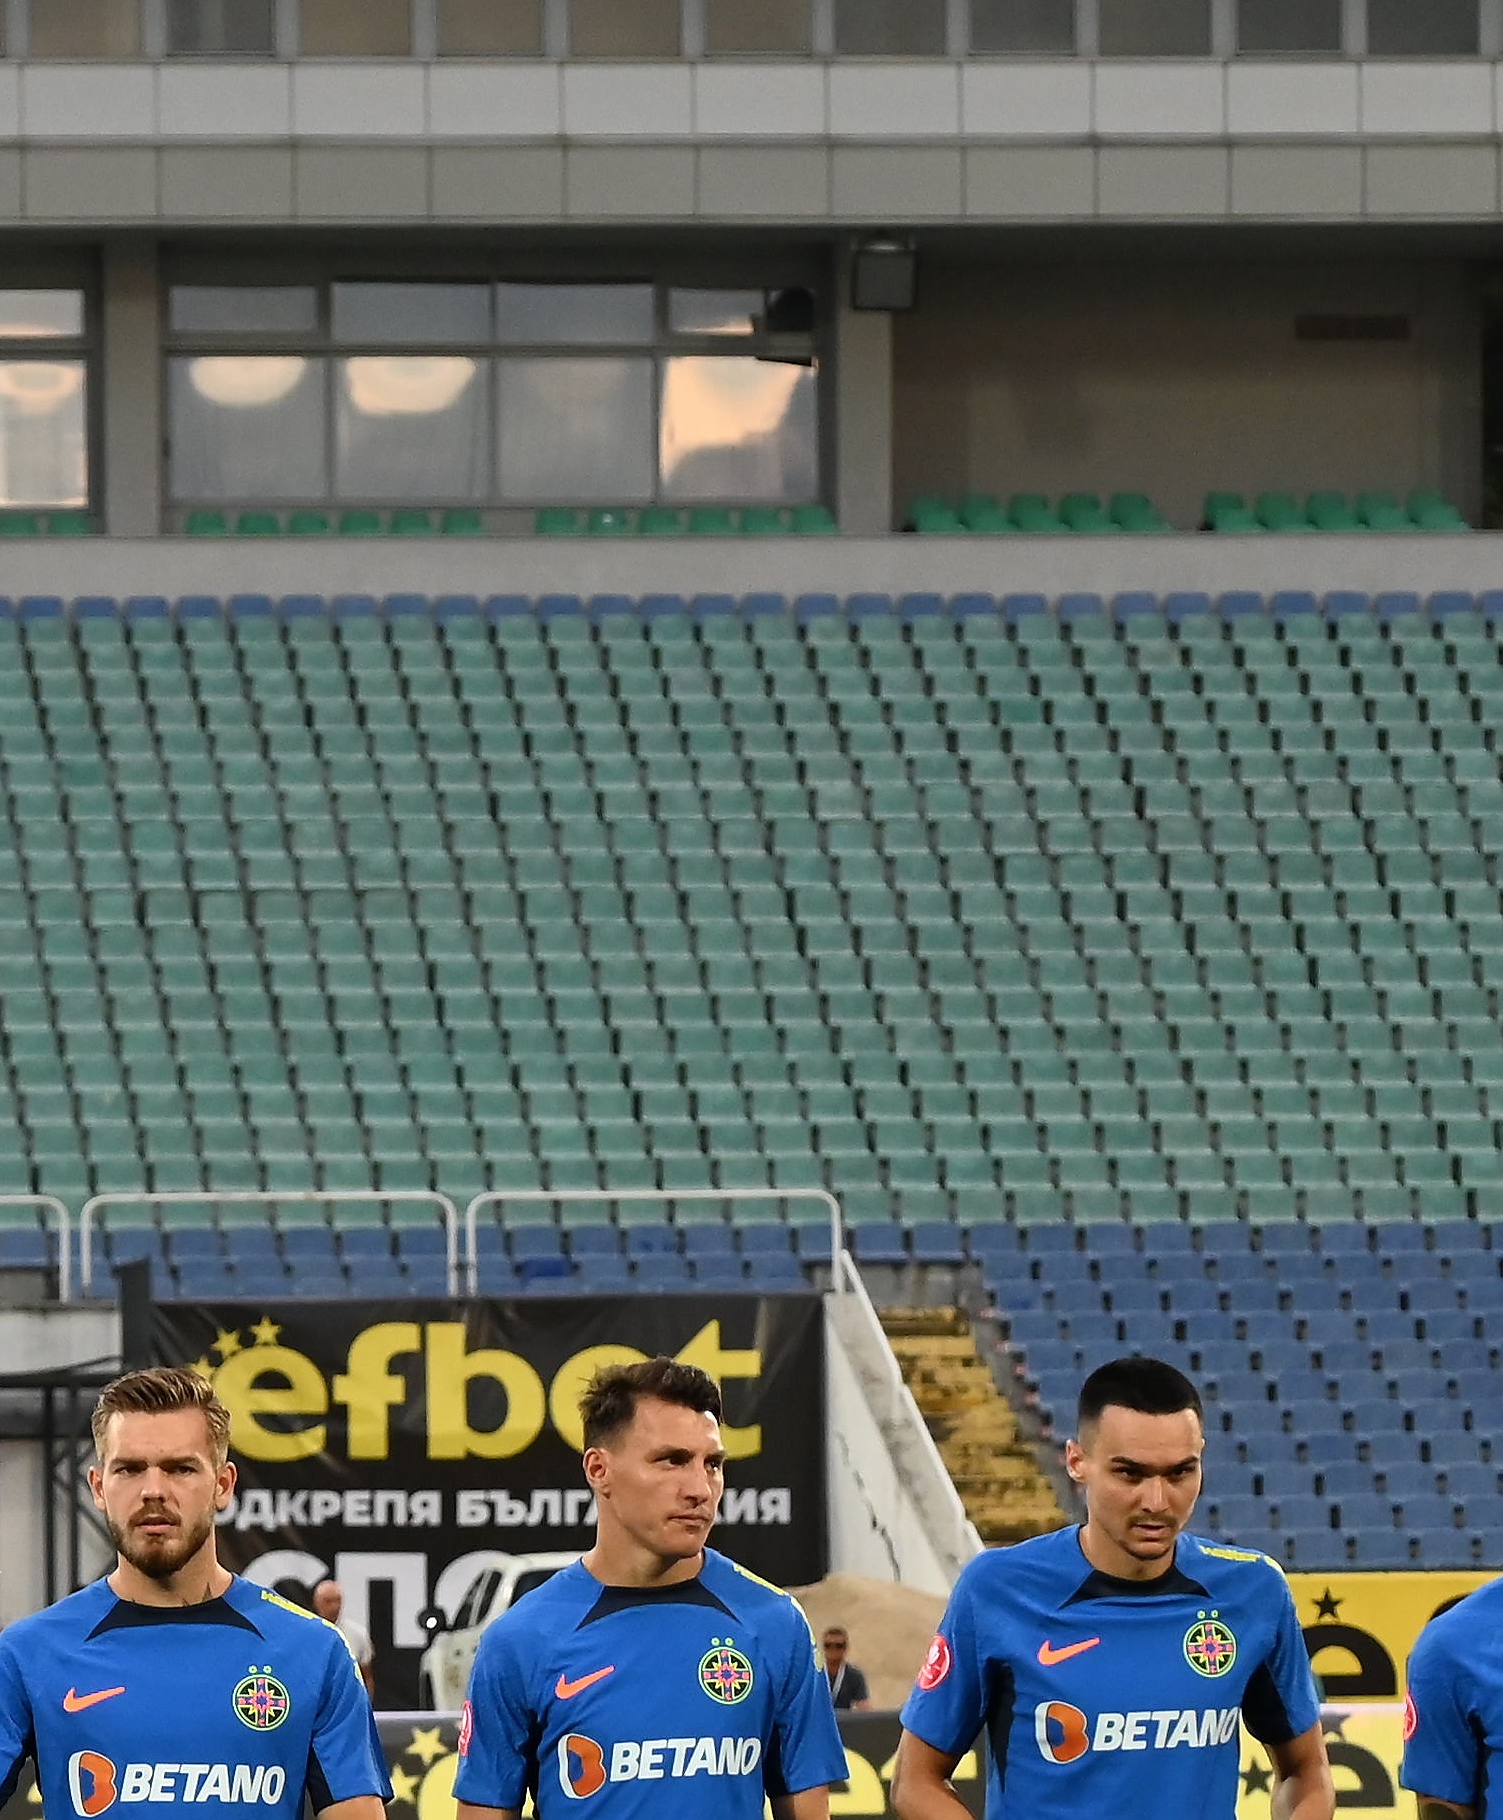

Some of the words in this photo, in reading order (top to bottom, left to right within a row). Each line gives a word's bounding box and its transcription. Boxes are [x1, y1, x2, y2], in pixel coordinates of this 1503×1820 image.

[1093, 1707, 1241, 1749] BETANO
[609, 1737, 761, 1782] BETANO
[120, 1763, 286, 1805] BETANO
